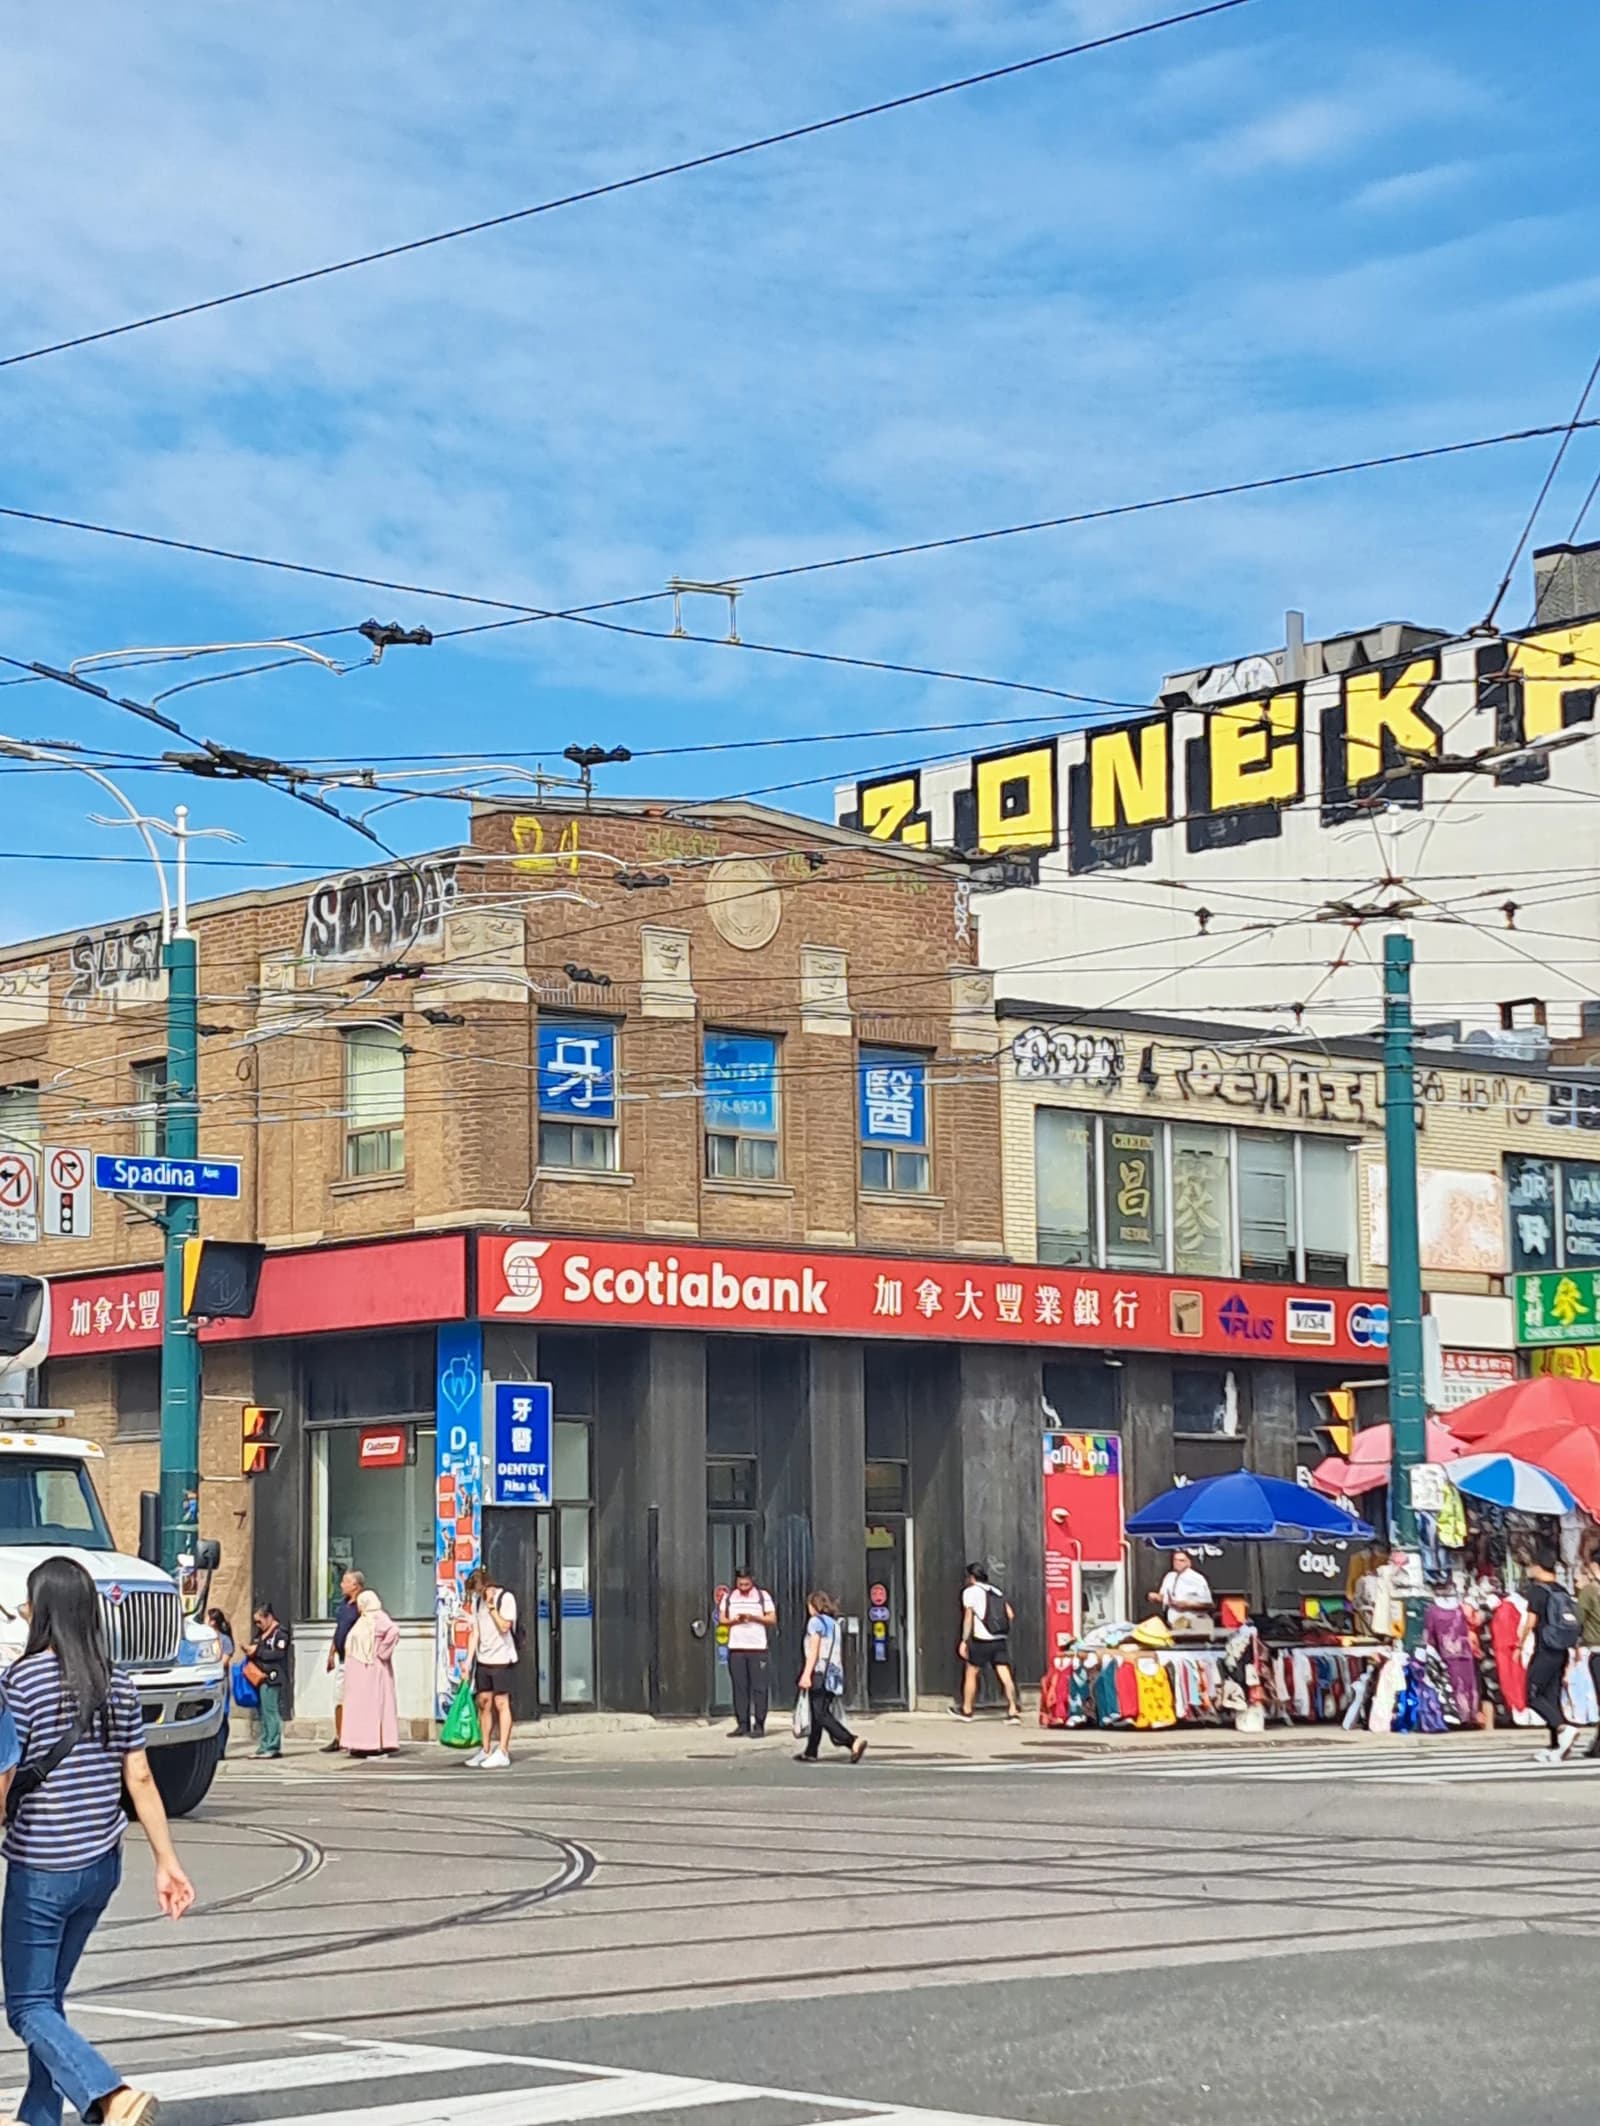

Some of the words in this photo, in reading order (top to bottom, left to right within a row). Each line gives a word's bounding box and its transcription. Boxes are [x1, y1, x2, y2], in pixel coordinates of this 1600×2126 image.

[546, 1036, 603, 1108] 牙
[864, 1067, 915, 1138] 醫
[114, 1159, 196, 1188] Spadina
[202, 1166, 220, 1179] Ave
[562, 1254, 829, 1315] Scotiabank
[872, 1273, 1140, 1330] 加拿大豐業銀行
[69, 1288, 160, 1336] 加拿大豐
[1230, 1316, 1274, 1341] PLUS
[1295, 1312, 1327, 1330] VISA
[497, 1462, 546, 1477] DENTIST
